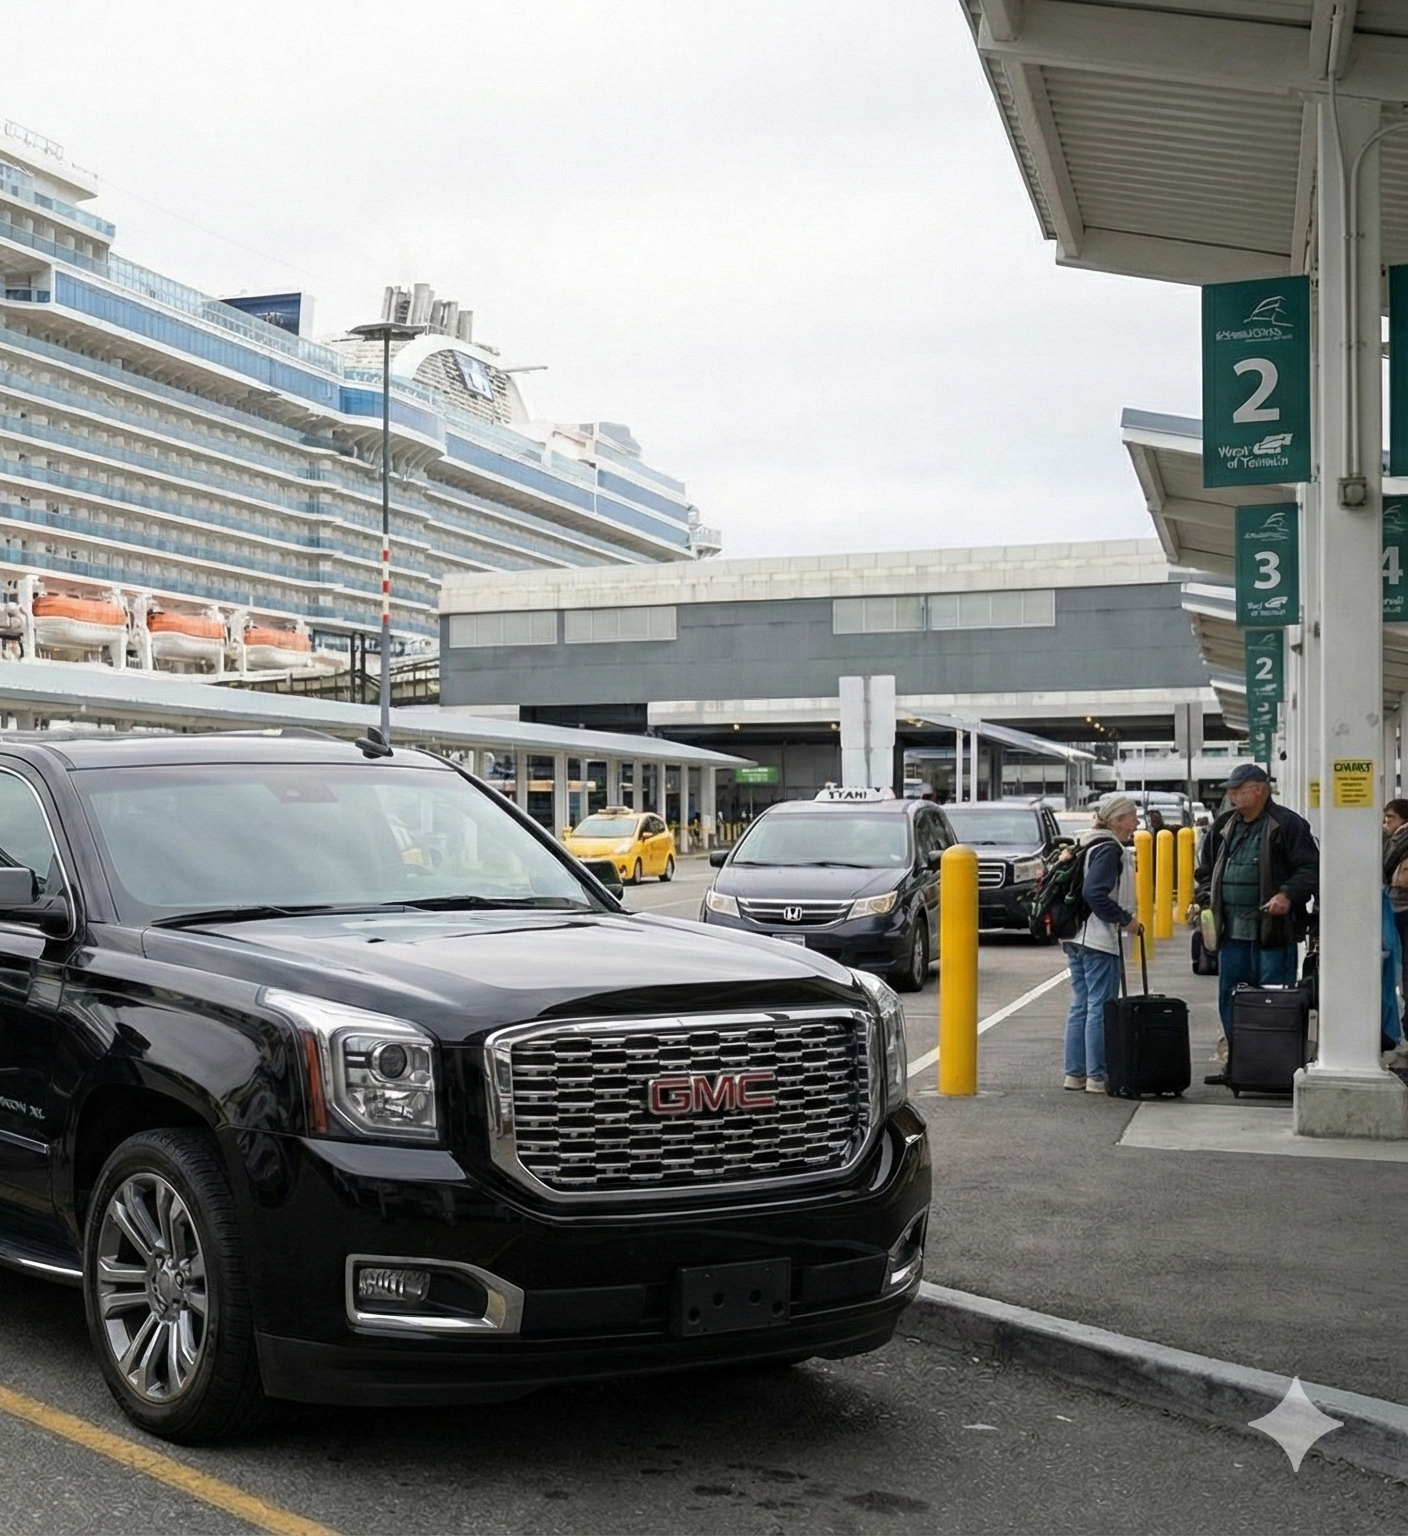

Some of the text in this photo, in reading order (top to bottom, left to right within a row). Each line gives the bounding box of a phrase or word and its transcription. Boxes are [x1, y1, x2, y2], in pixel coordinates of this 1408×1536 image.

[1233, 358, 1280, 423] 2
[1254, 551, 1281, 589] 3
[1382, 546, 1403, 585] 4
[1255, 657, 1273, 679] 2
[648, 1072, 776, 1115] GMC
